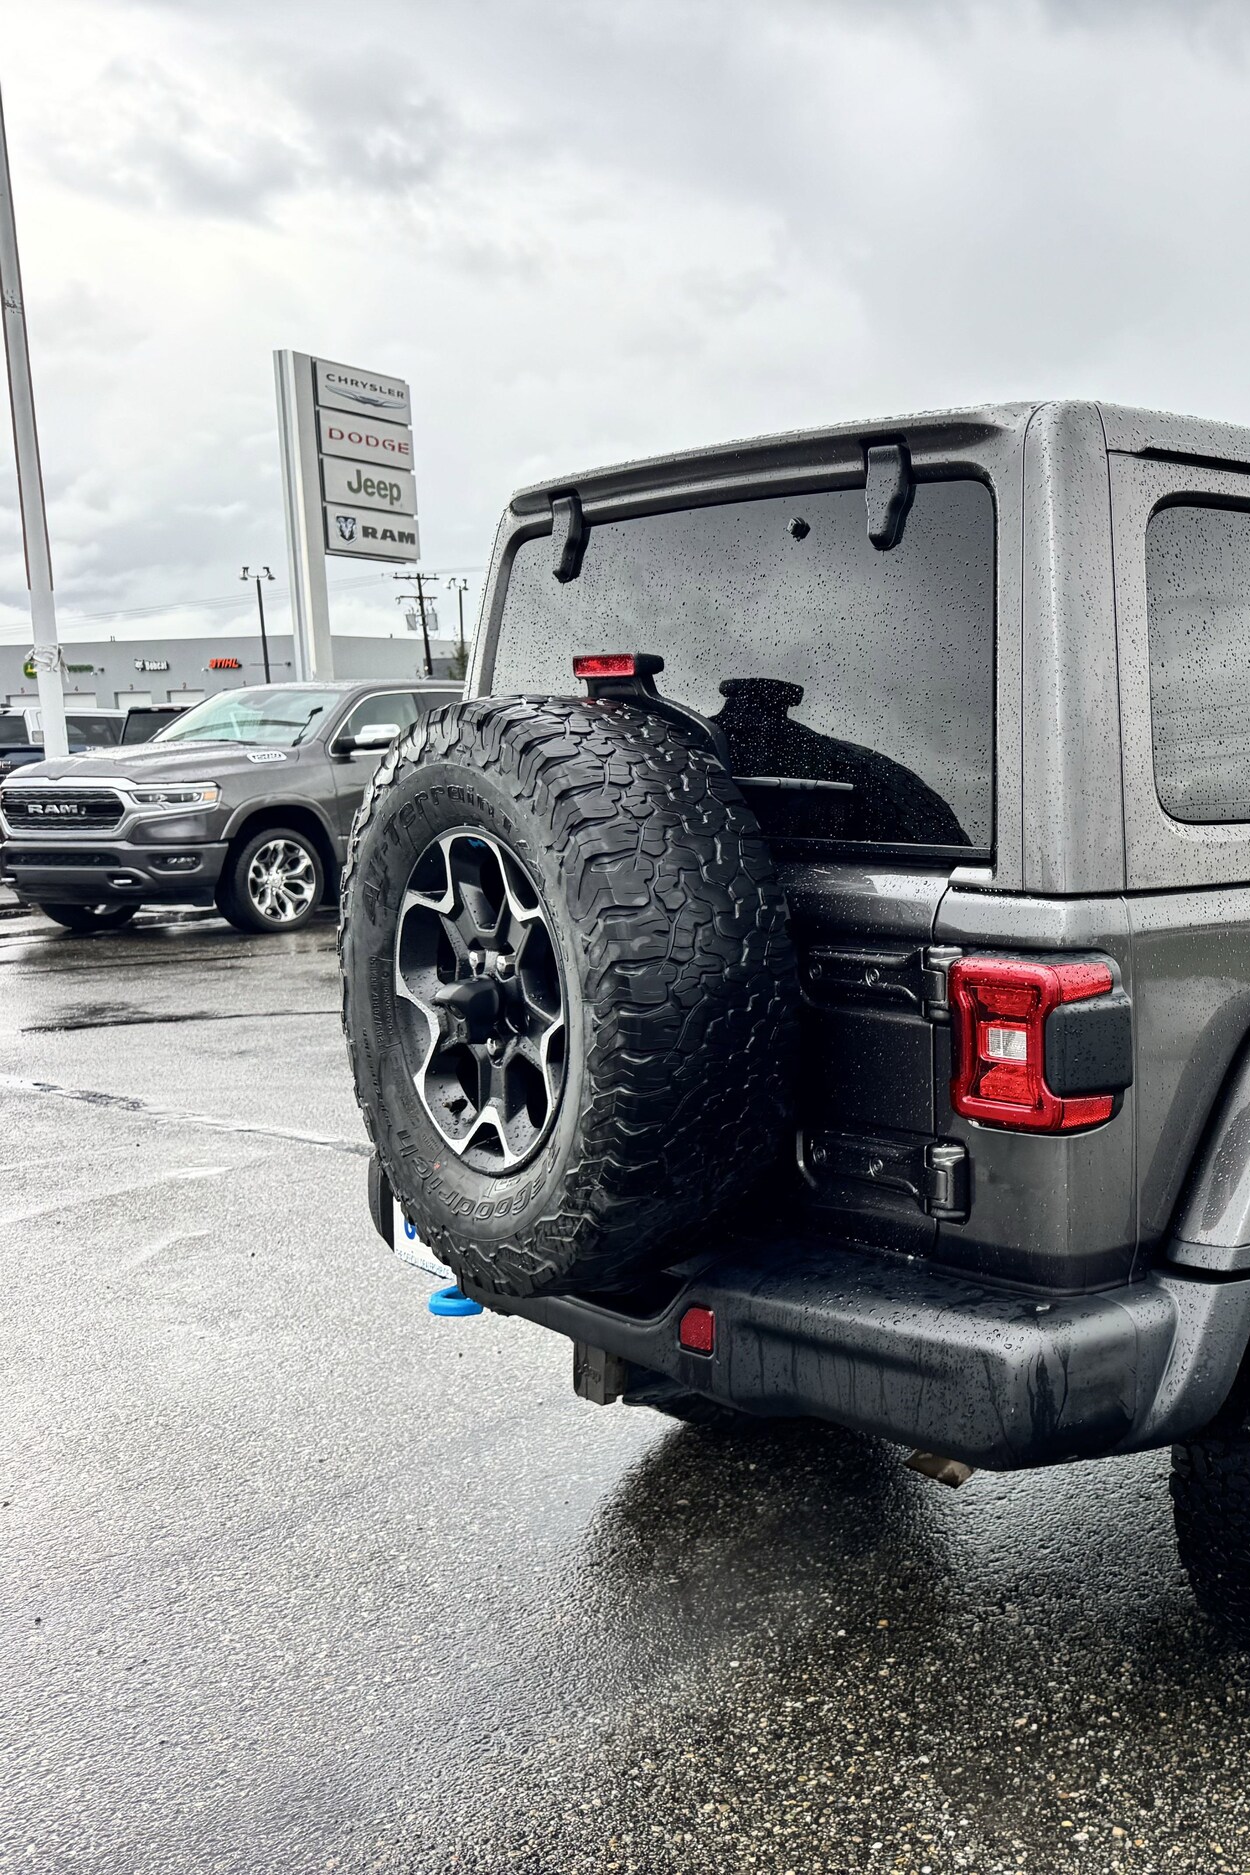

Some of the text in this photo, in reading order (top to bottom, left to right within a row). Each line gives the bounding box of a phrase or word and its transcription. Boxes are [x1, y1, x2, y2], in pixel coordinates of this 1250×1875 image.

[326, 373, 405, 399] CHRYSLER
[328, 427, 410, 455] DODGE
[347, 469, 402, 505] Jeep
[362, 525, 416, 545] RAM
[145, 660, 169, 671] Bobcat
[208, 658, 239, 669] STIHL
[27, 804, 78, 814] RAM
